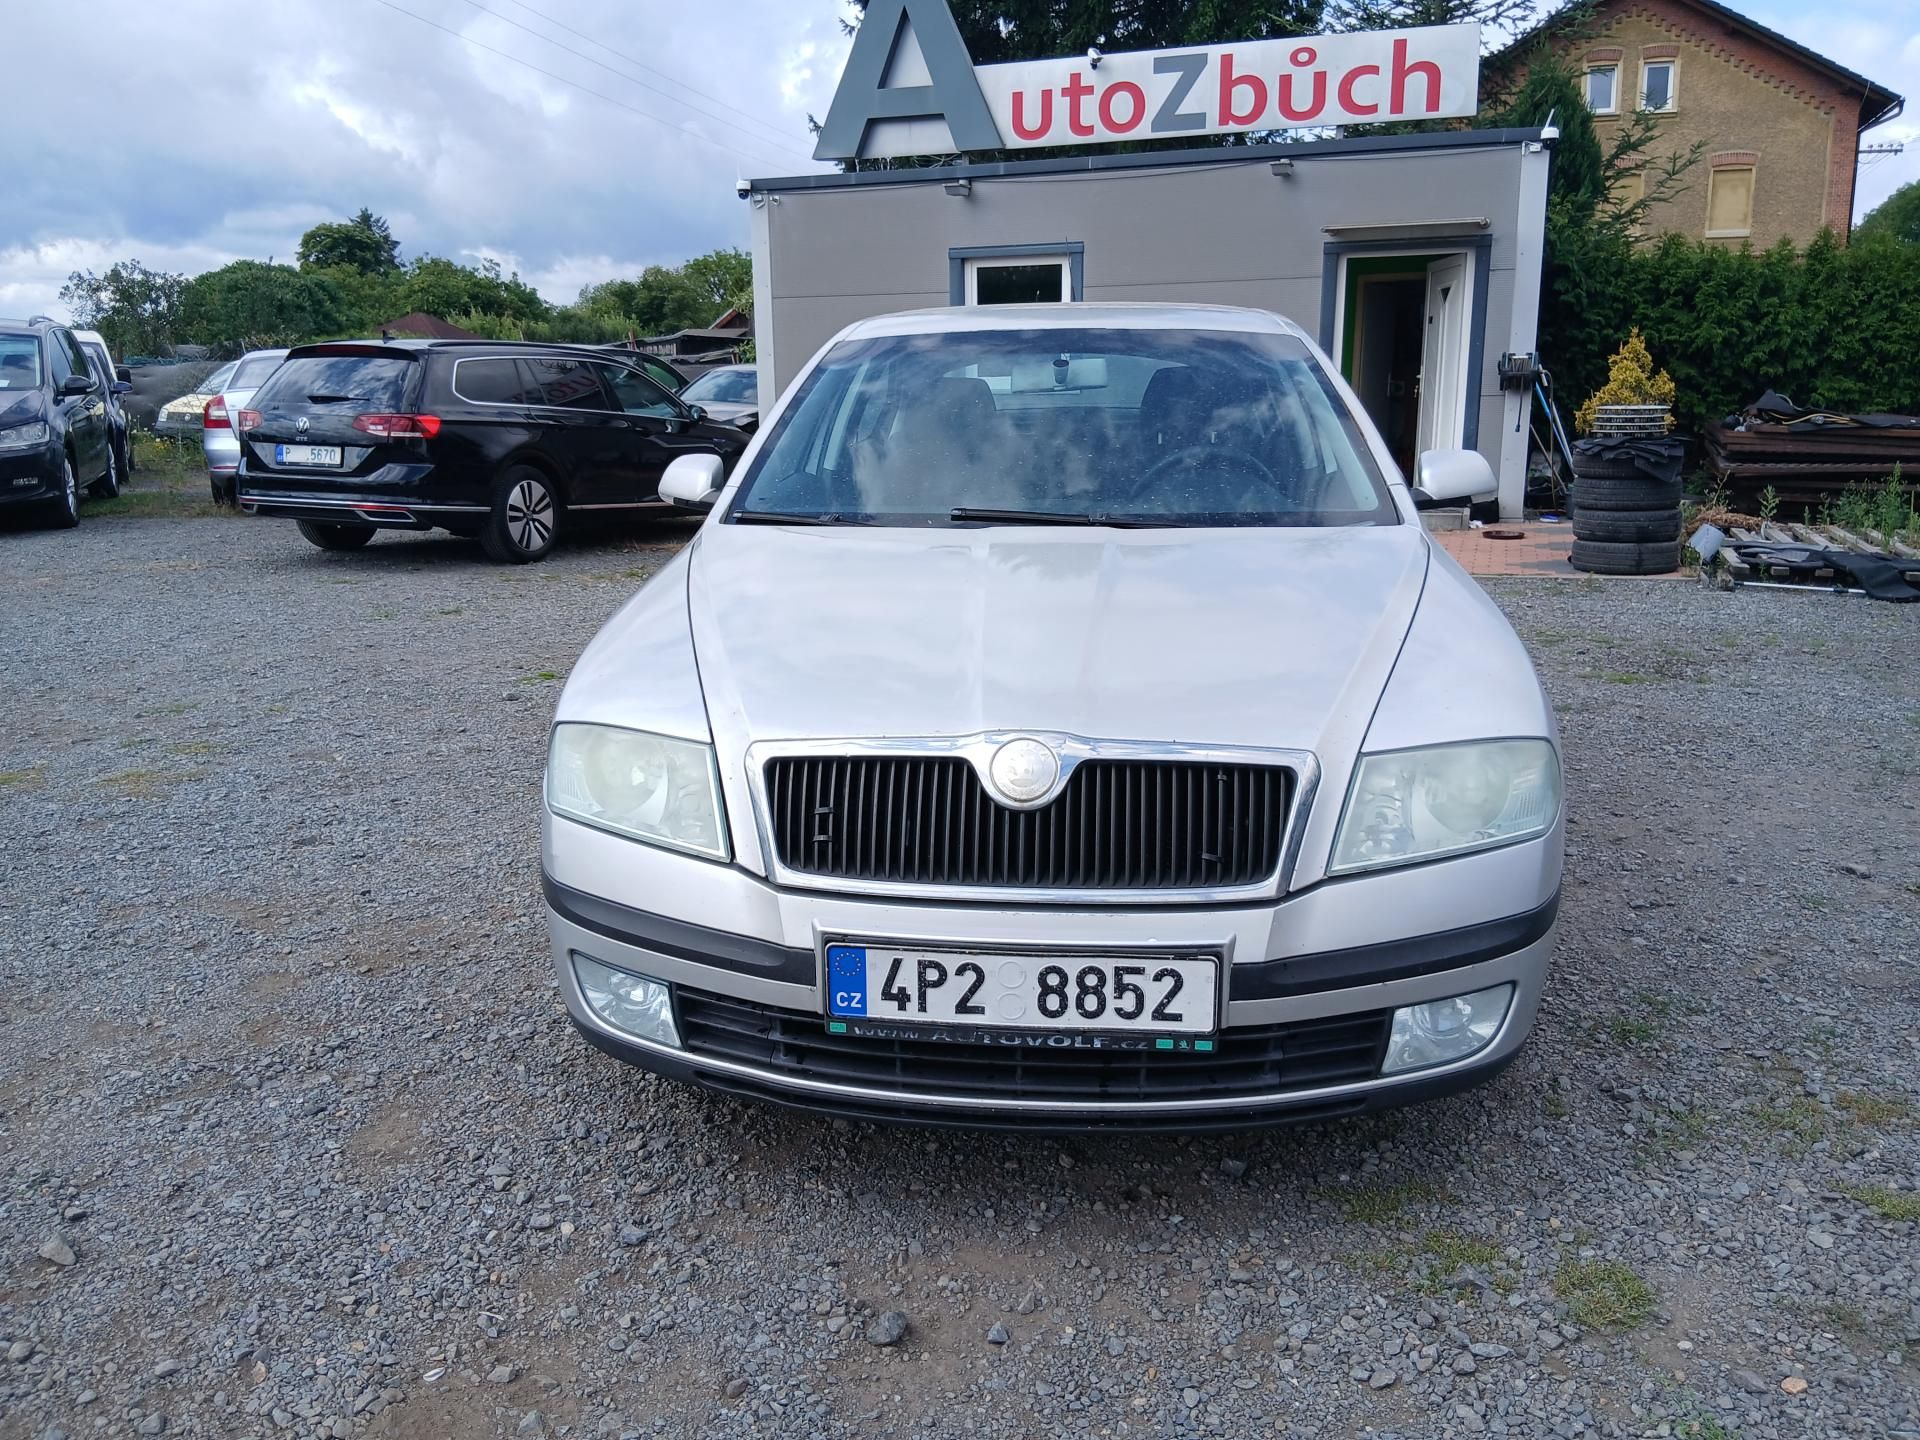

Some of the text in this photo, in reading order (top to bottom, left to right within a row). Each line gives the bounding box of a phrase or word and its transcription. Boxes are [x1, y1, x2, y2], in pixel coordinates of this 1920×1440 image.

[812, 0, 1443, 161] AutoZbůch
[836, 991, 862, 1009] CZ
[880, 957, 1184, 1022] 4P2 8852
